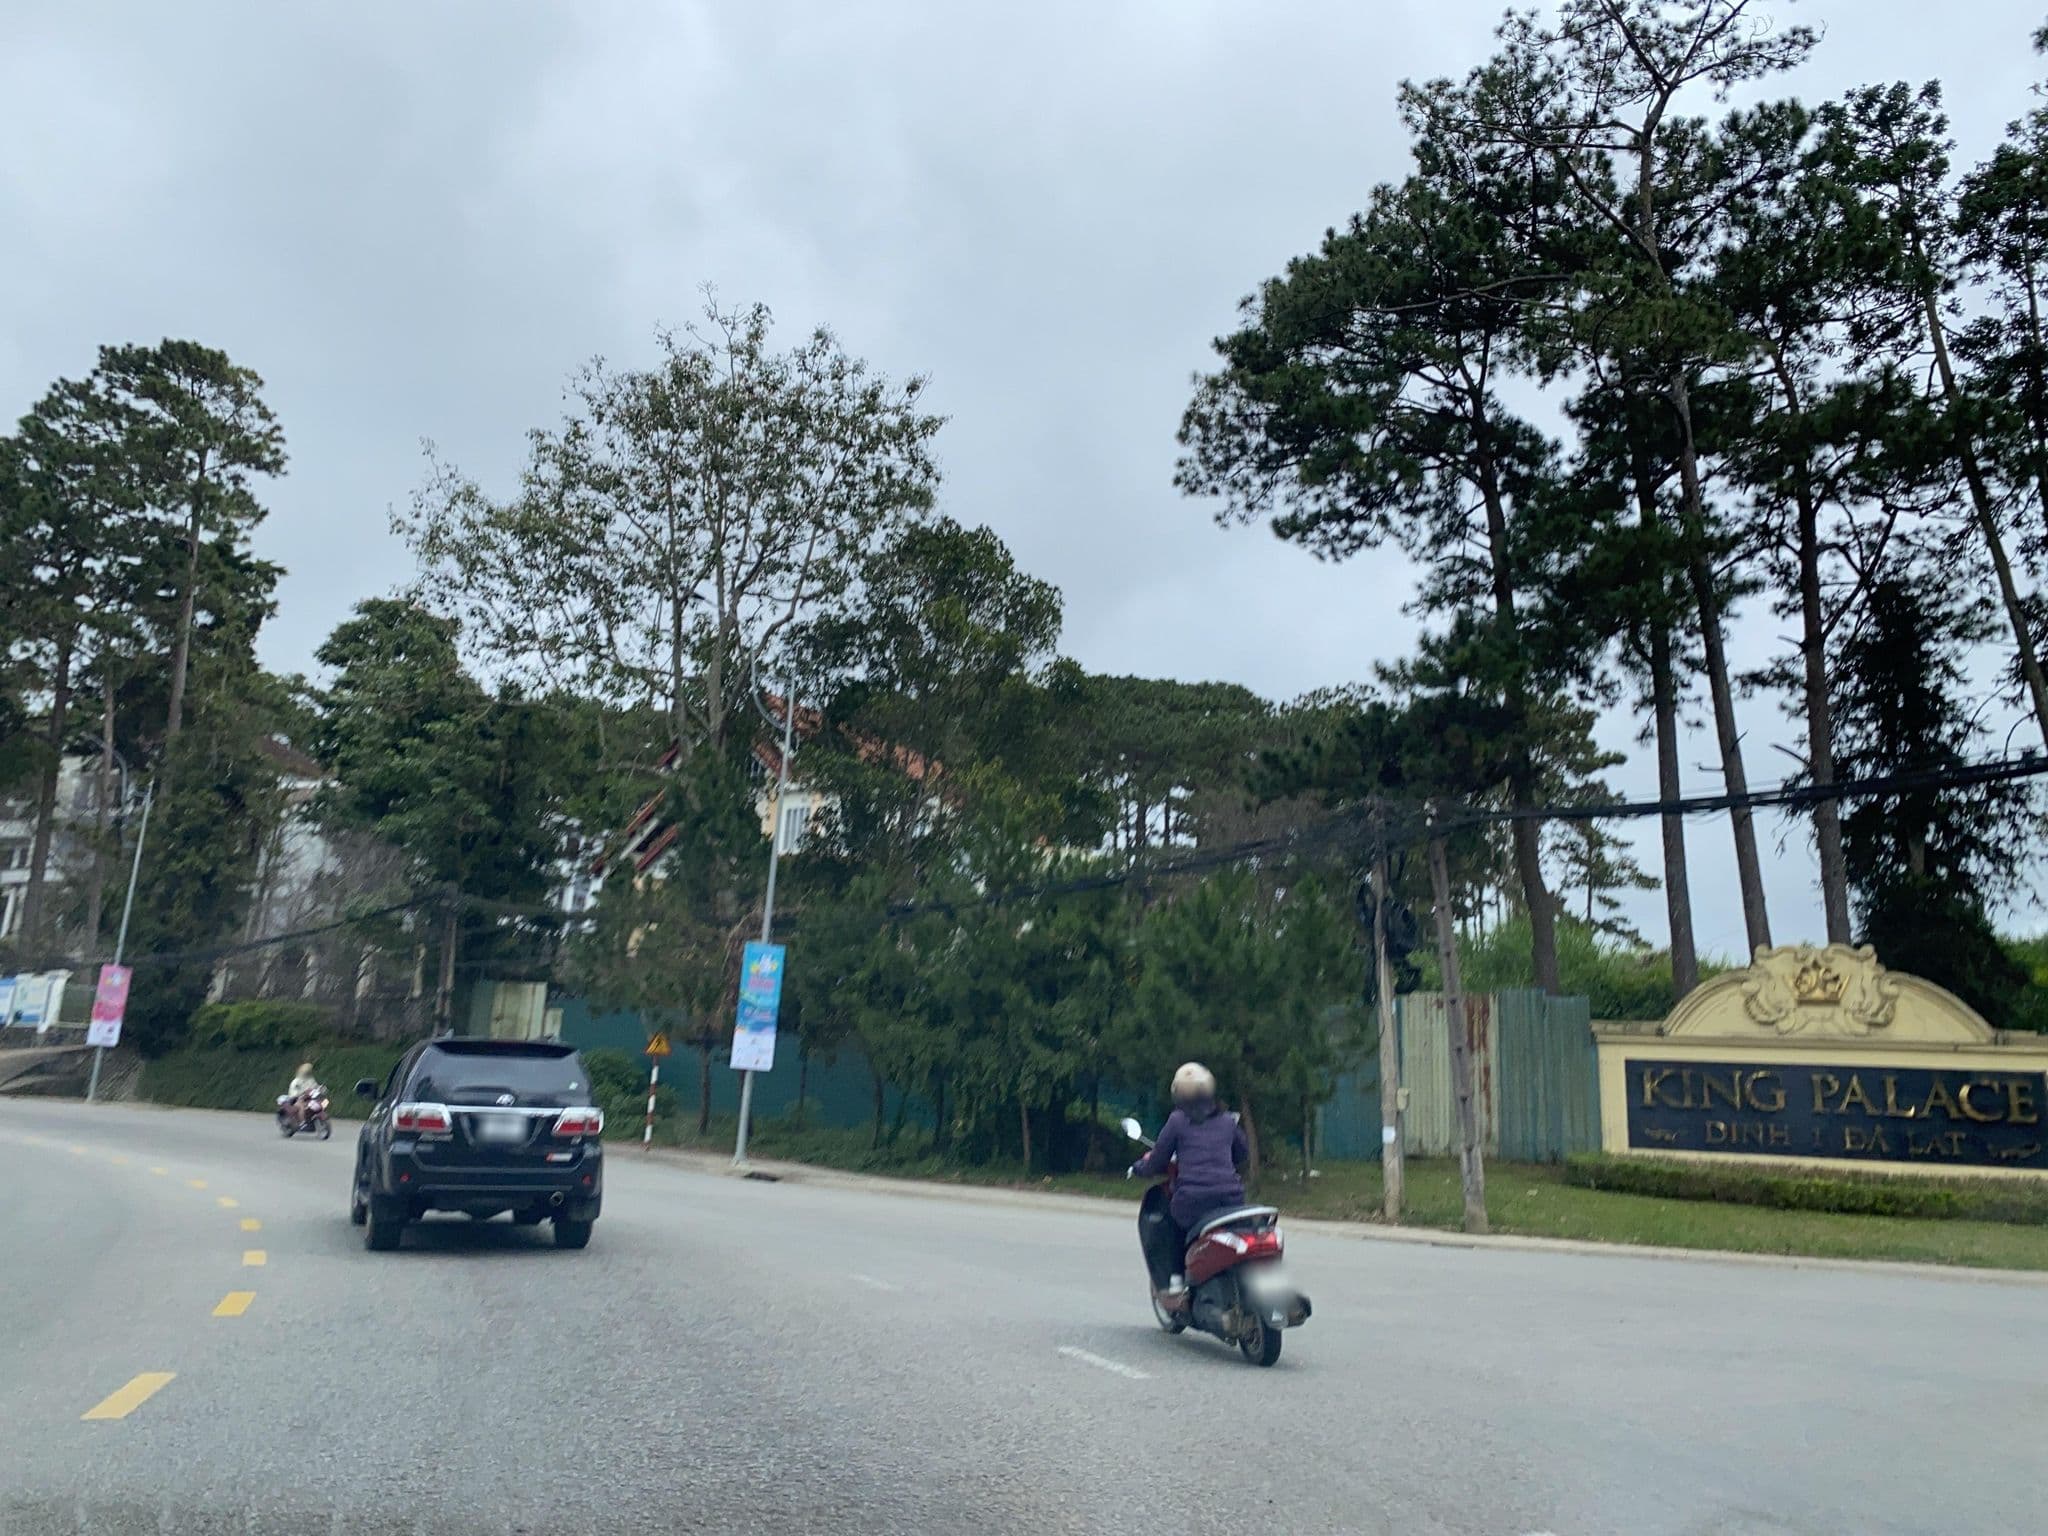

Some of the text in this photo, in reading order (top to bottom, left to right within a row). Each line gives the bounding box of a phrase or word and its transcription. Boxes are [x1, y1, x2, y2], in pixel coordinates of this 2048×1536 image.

[1641, 1069, 2038, 1124] KING PALACE
[1704, 1119, 1792, 1146] DINH
